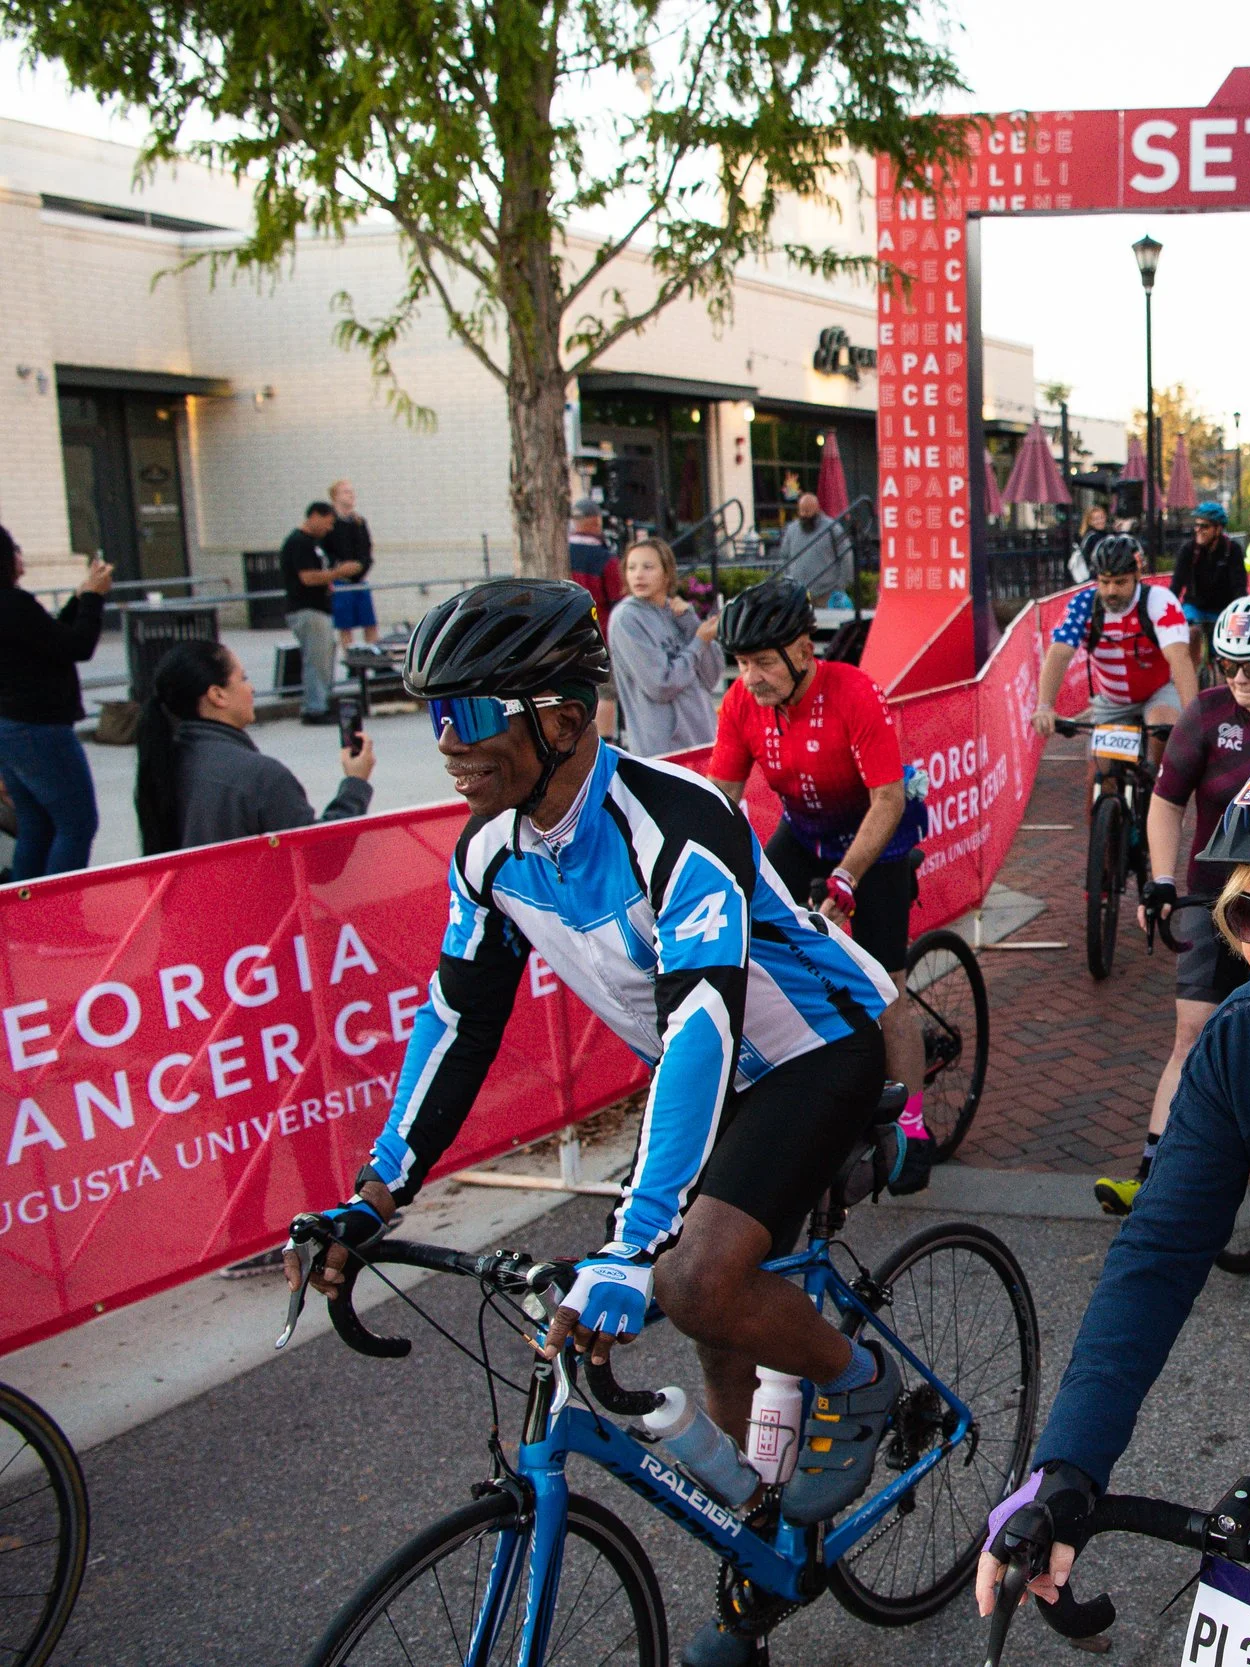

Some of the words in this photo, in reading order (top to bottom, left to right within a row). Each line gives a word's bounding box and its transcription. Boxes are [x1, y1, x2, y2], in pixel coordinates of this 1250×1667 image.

[1095, 733, 1139, 751] PL2027
[1217, 737, 1243, 751] PAC
[675, 890, 728, 943] 4
[175, 1071, 399, 1170] UNIVERSITY
[640, 1454, 742, 1538] RALEIGH
